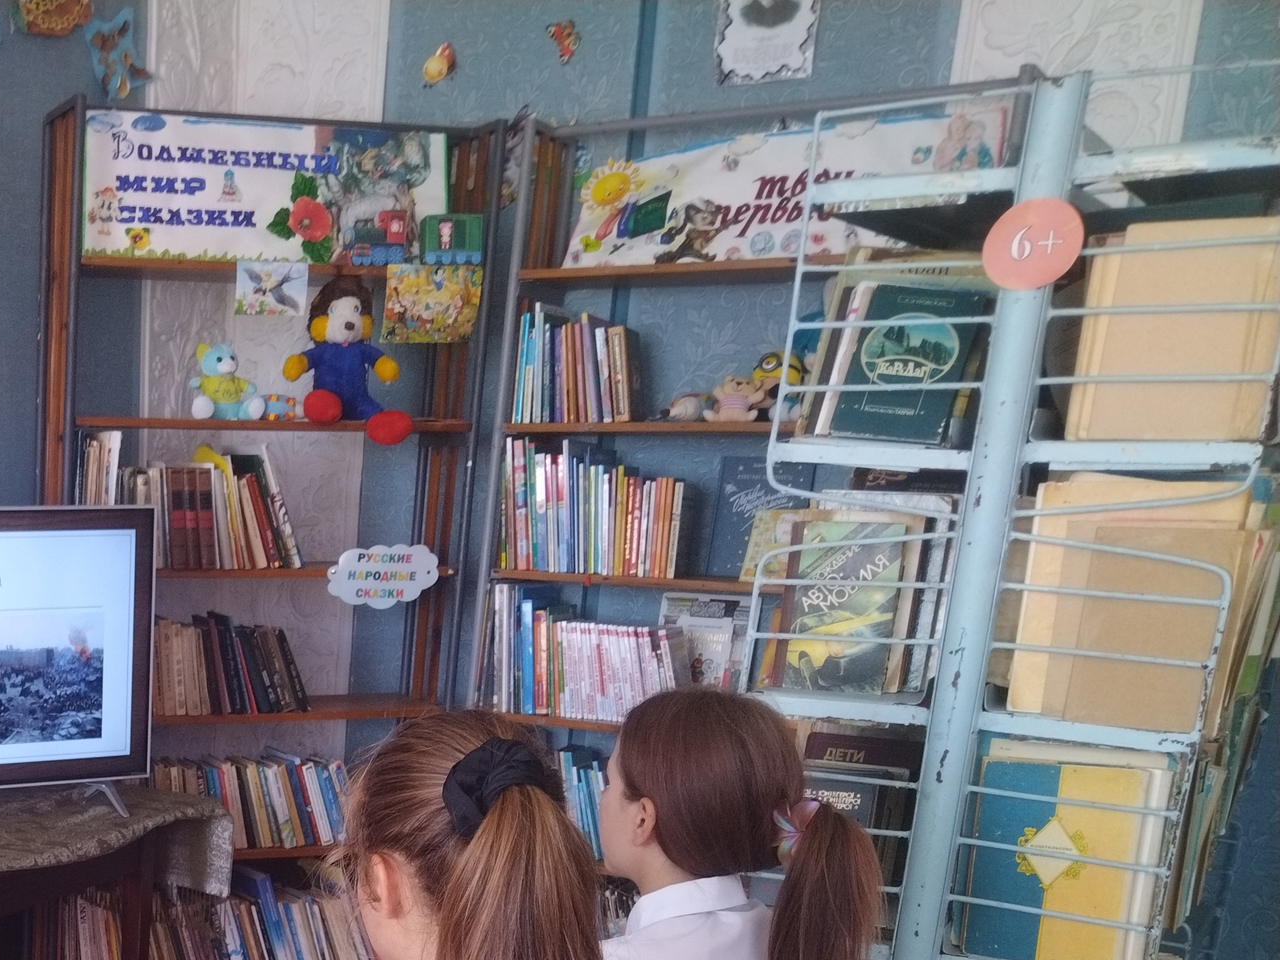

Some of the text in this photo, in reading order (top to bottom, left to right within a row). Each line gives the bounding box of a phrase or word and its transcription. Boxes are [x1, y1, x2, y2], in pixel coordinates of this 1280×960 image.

[112, 131, 340, 175] ВОЛШЕБНЫЙ
[116, 175, 206, 196] МИР
[117, 204, 256, 228] СКАЗКИ
[1011, 225, 1063, 261] 6+
[357, 553, 413, 564] РУССКИЕ
[347, 570, 417, 583] НАРОДНЫЕ
[355, 588, 404, 598] СКАЗКИ
[823, 747, 866, 763] ДЕТИ
